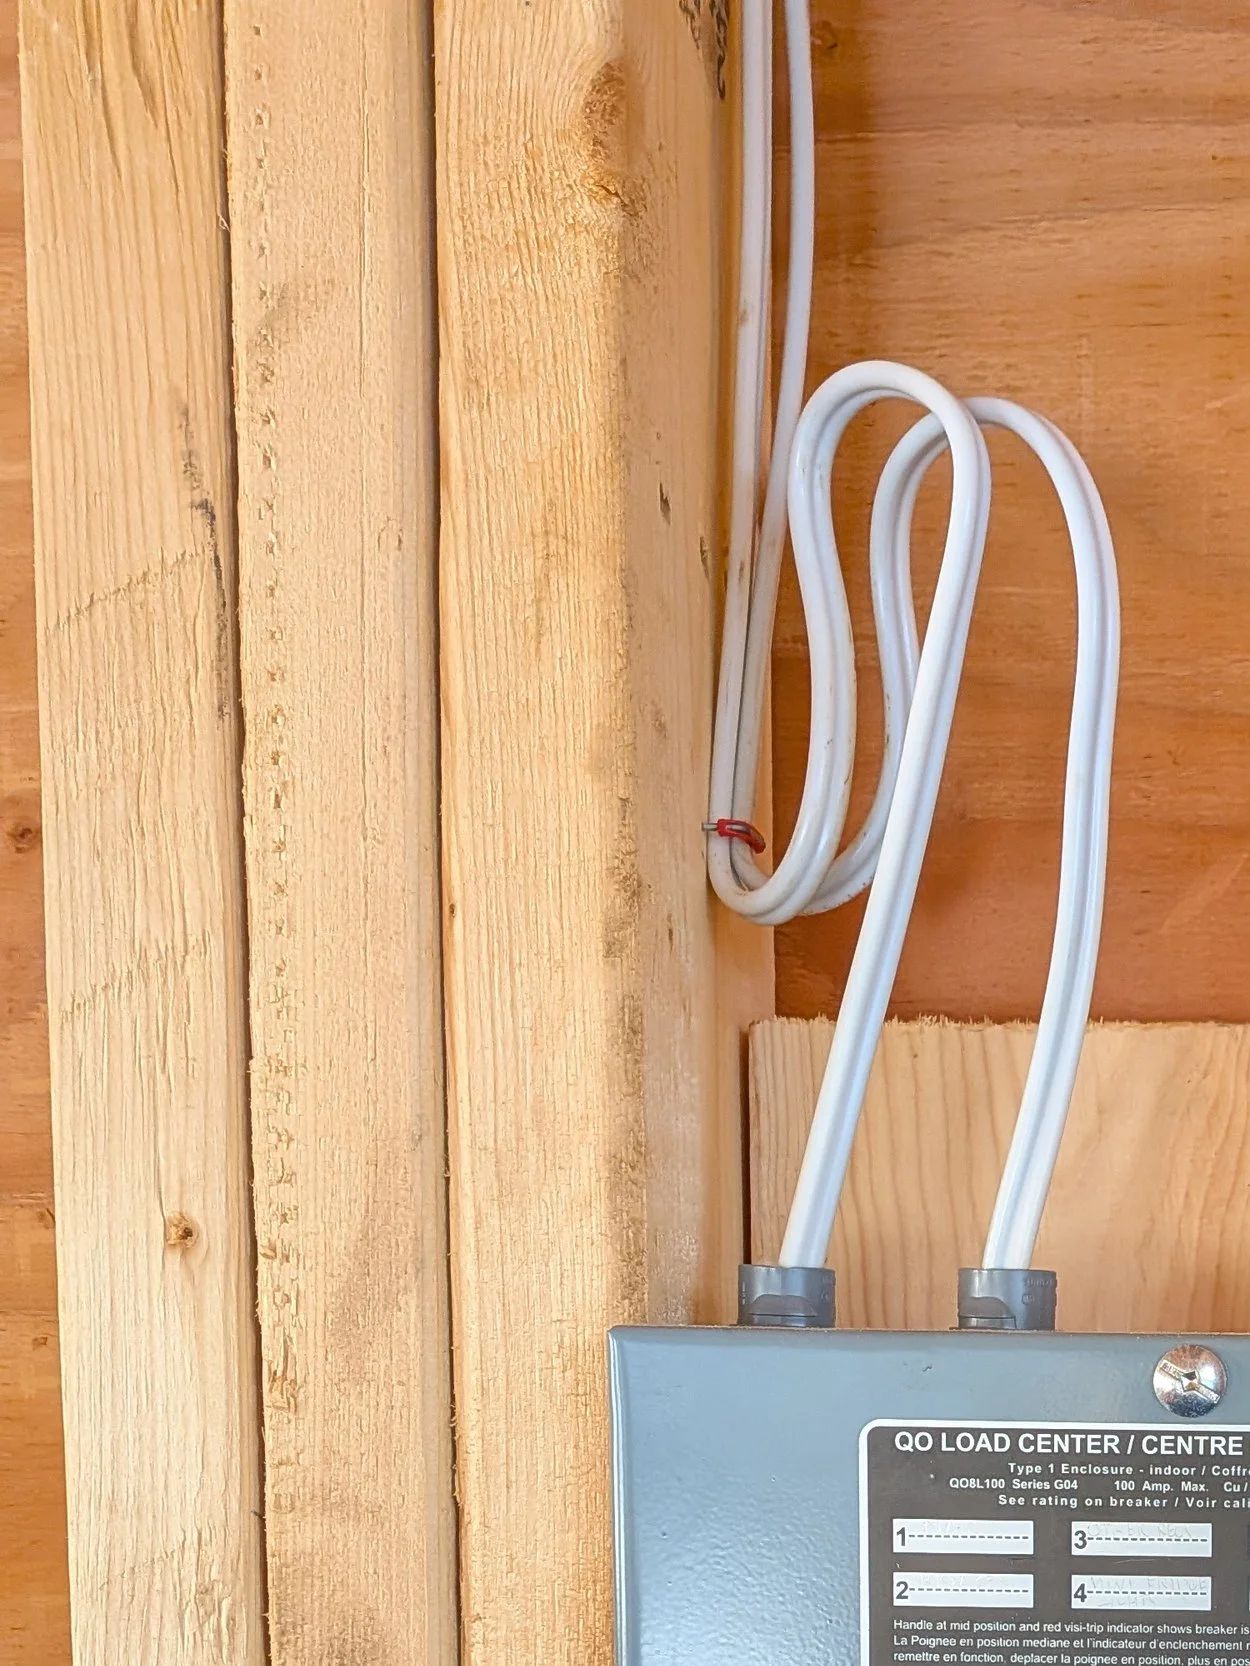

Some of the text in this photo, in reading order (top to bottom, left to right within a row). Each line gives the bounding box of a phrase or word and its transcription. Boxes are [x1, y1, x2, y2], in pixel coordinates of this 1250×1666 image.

[894, 1431, 932, 1452] QO
[941, 1432, 1010, 1452] LOAD
[1018, 1433, 1120, 1454] CENTER
[1142, 1435, 1242, 1455] CENTRE
[1008, 1463, 1041, 1475] Type
[1047, 1463, 1054, 1473] 1
[1061, 1463, 1132, 1475] Enclosure
[1149, 1464, 1196, 1475] indoor
[1012, 1478, 1050, 1489] Series
[1054, 1479, 1078, 1489] G04
[1114, 1480, 1134, 1490] 100
[1142, 1480, 1173, 1493] Amp.
[1181, 1481, 1208, 1492] Max.
[1223, 1481, 1240, 1492] Cu
[998, 1494, 1024, 1505] See
[1032, 1495, 1077, 1508] rating
[1084, 1498, 1102, 1506] on
[1110, 1496, 1167, 1507] breaker
[1185, 1497, 1216, 1508] Voir
[896, 1527, 906, 1546] 1
[1074, 1531, 1087, 1549] 3
[896, 1581, 908, 1599] 2
[1073, 1584, 1087, 1602] 4
[894, 1619, 932, 1630] Handle
[950, 1620, 970, 1630] mid
[973, 1621, 1015, 1633] position
[1018, 1621, 1039, 1631] and
[1043, 1622, 1061, 1632] red
[1107, 1622, 1153, 1633] indicator
[1157, 1624, 1192, 1634] shows
[1195, 1624, 1237, 1634] breaker
[1240, 1625, 1249, 1634] is
